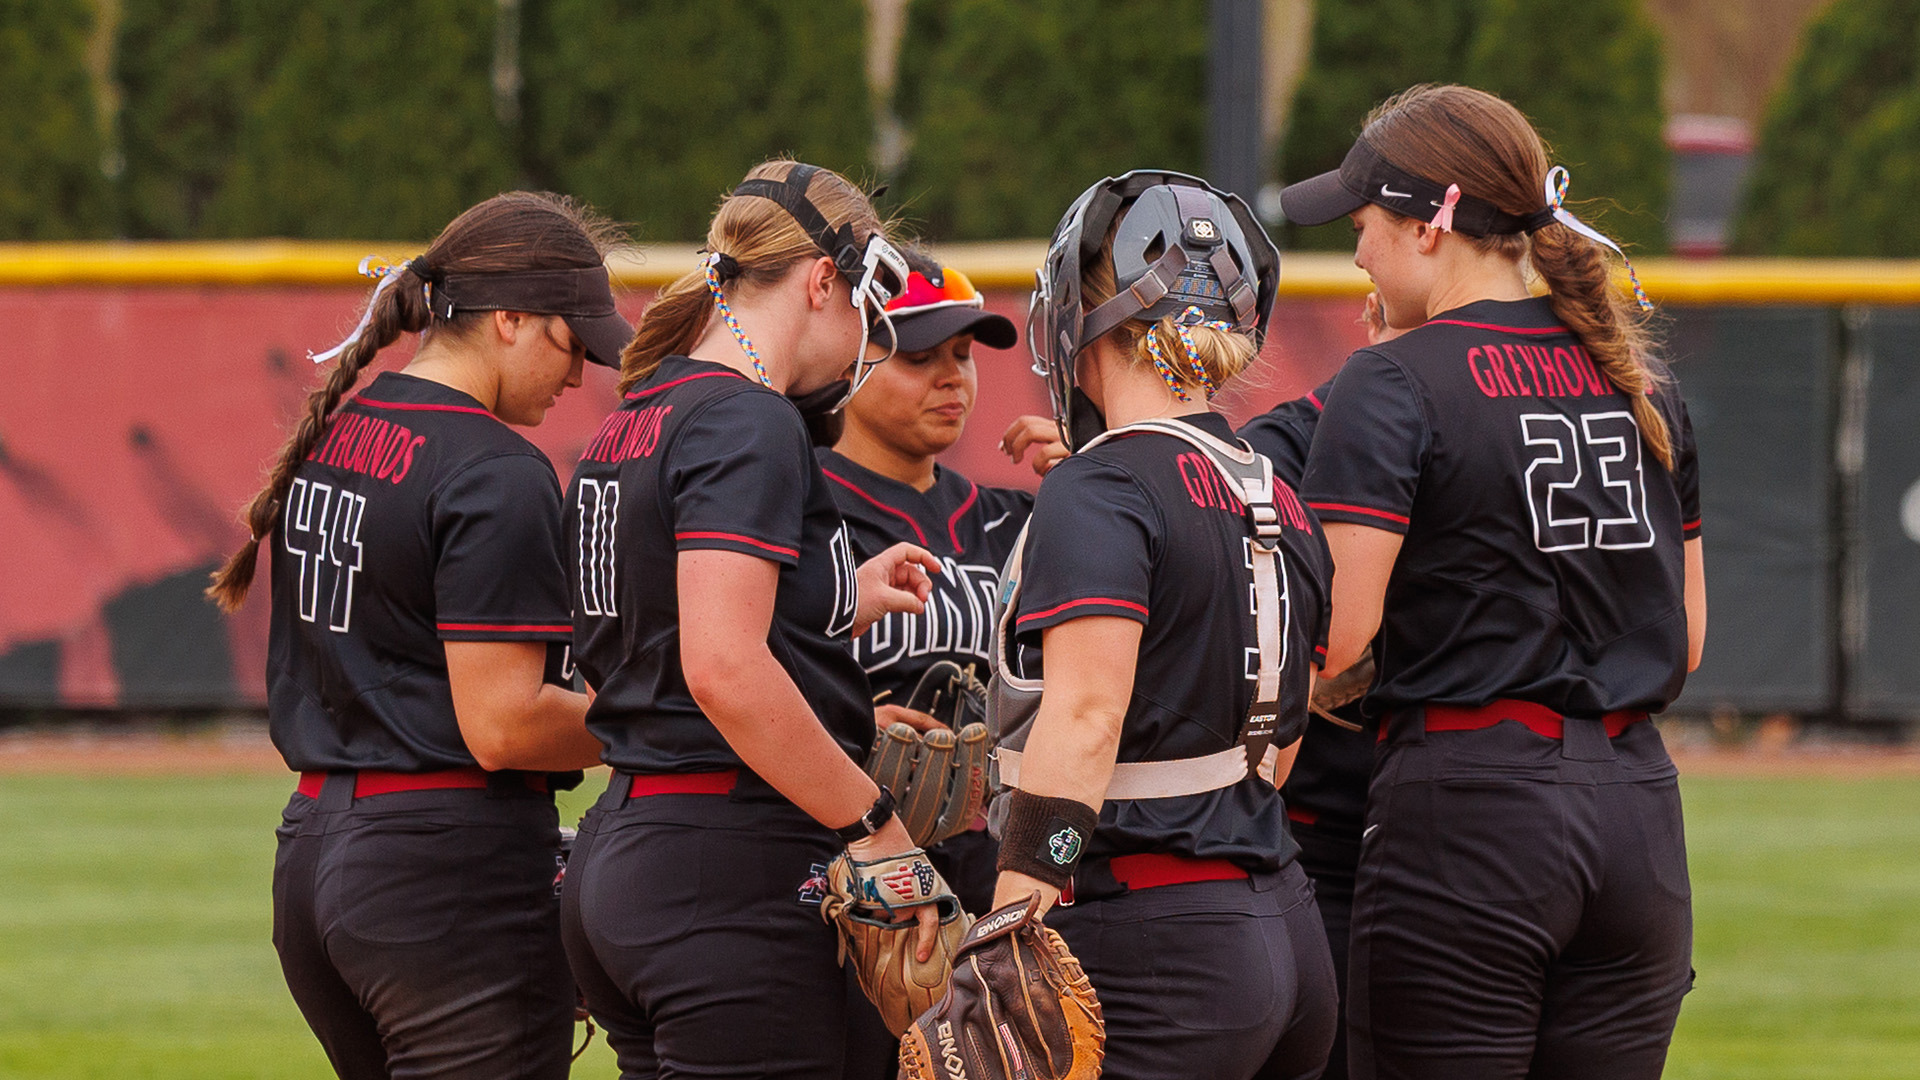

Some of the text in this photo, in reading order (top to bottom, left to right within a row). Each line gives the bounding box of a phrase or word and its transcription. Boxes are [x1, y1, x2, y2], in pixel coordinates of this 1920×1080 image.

[1467, 343, 1654, 398] GREYHOU
[306, 411, 426, 484] YHOUNDS
[1519, 411, 1655, 552] 23
[285, 477, 367, 634] 44
[578, 478, 620, 618] 11
